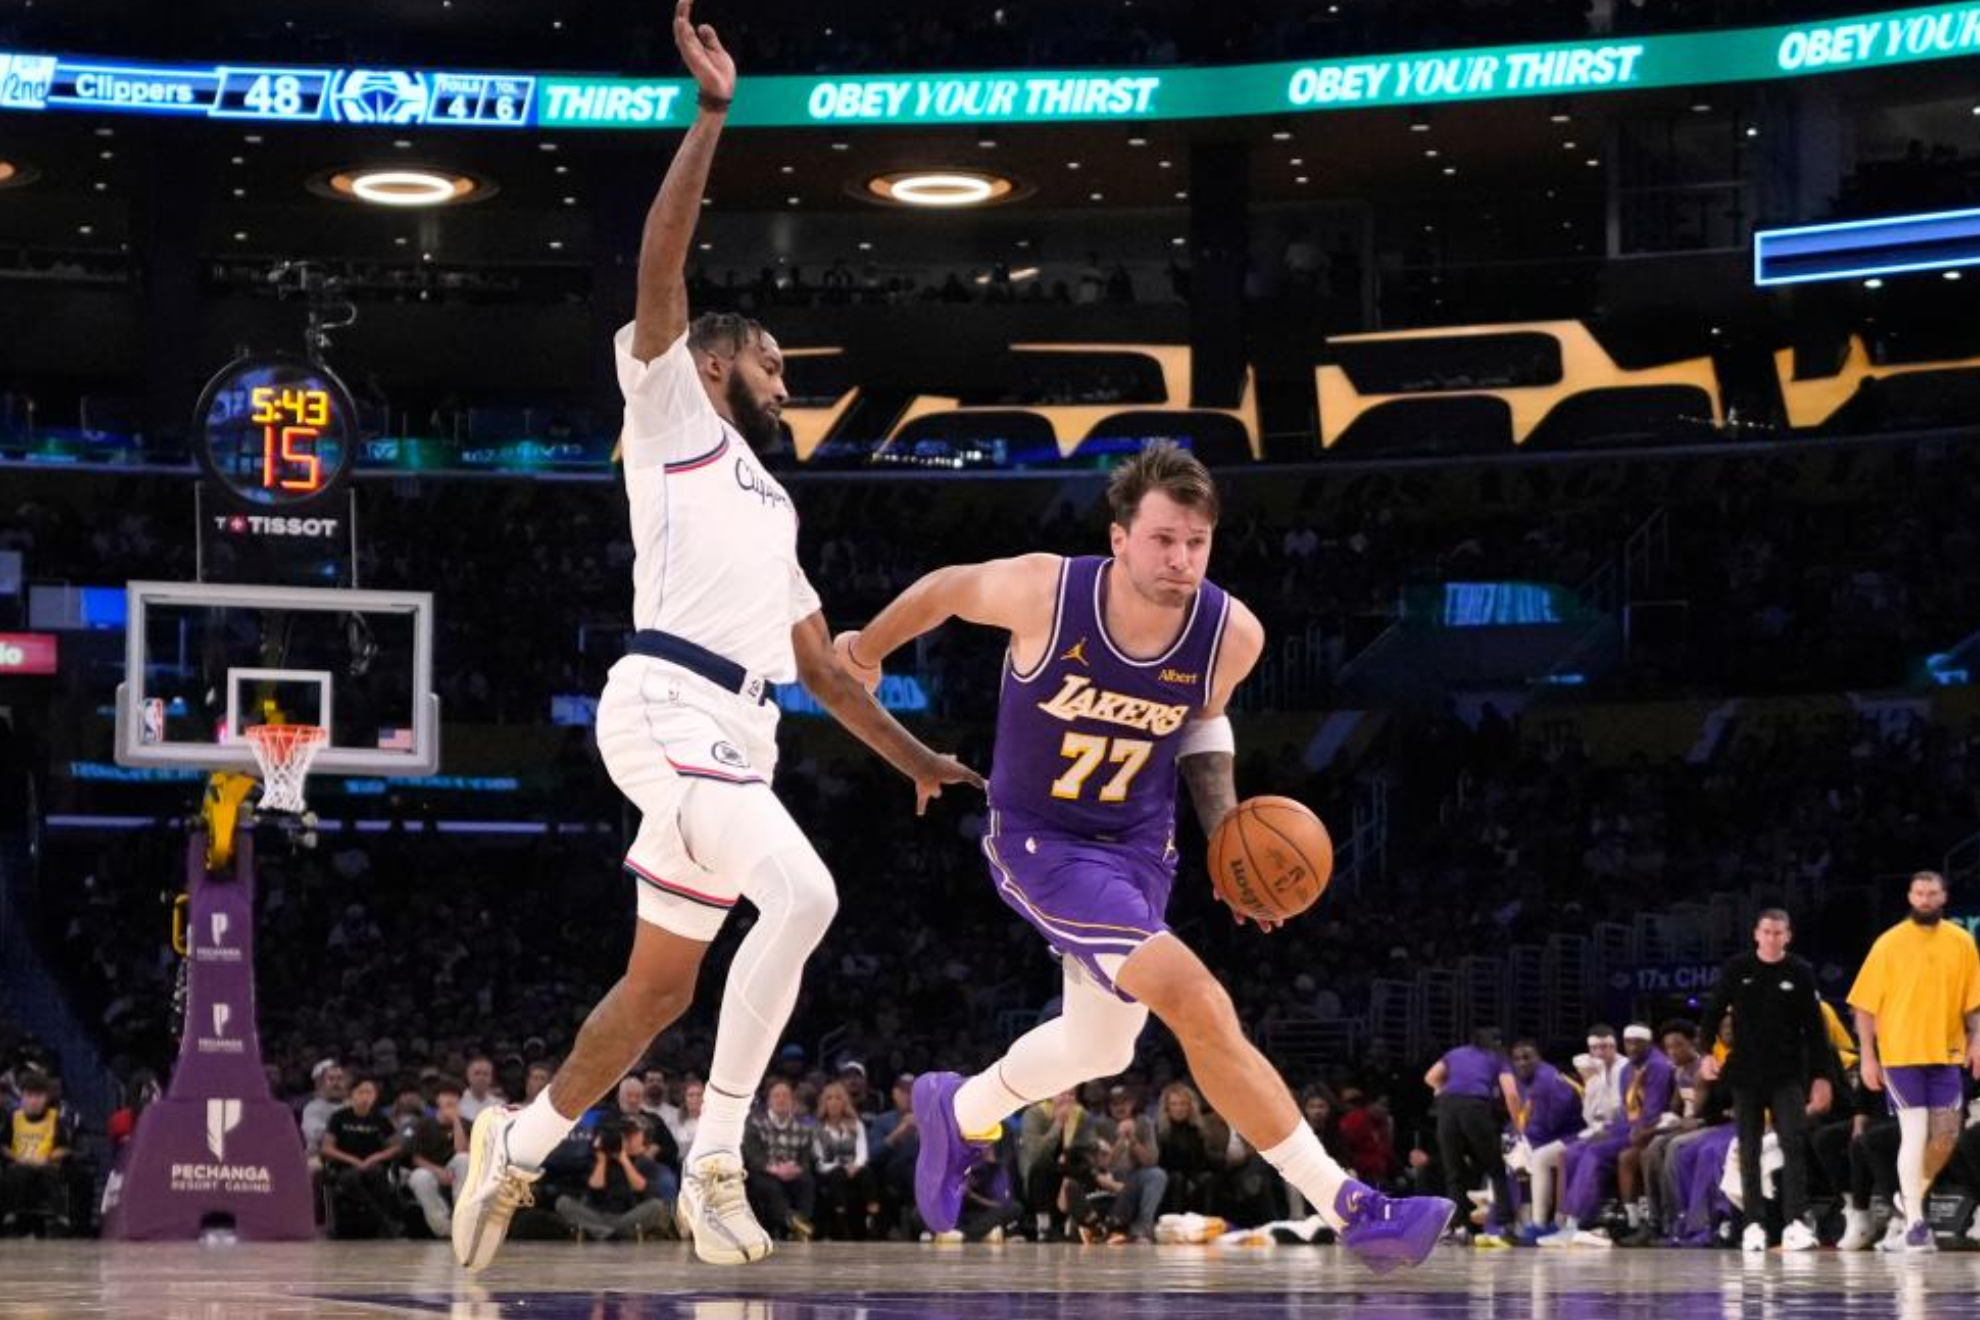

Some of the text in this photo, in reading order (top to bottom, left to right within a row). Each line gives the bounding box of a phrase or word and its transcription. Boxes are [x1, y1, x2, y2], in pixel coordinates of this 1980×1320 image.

[1777, 21, 1882, 71] OBEY
[10, 73, 47, 101] 2nd
[75, 73, 195, 102] Clippers
[1287, 44, 1643, 105] OBEY YOUR THIRST
[243, 74, 302, 115] 48
[447, 94, 467, 119] 4
[497, 95, 515, 120] 6
[545, 84, 680, 121] THIRST
[808, 76, 1160, 119] OBEY YOUR THIRST
[251, 387, 329, 426] 5:43
[263, 425, 319, 490] 15
[248, 516, 337, 537] TISSOT
[1158, 668, 1197, 685] Albert
[1037, 673, 1190, 737] LAKERS
[1050, 731, 1154, 803] 77
[171, 1163, 270, 1182] PECHANGA
[171, 1181, 272, 1193] RESORT CASINO
